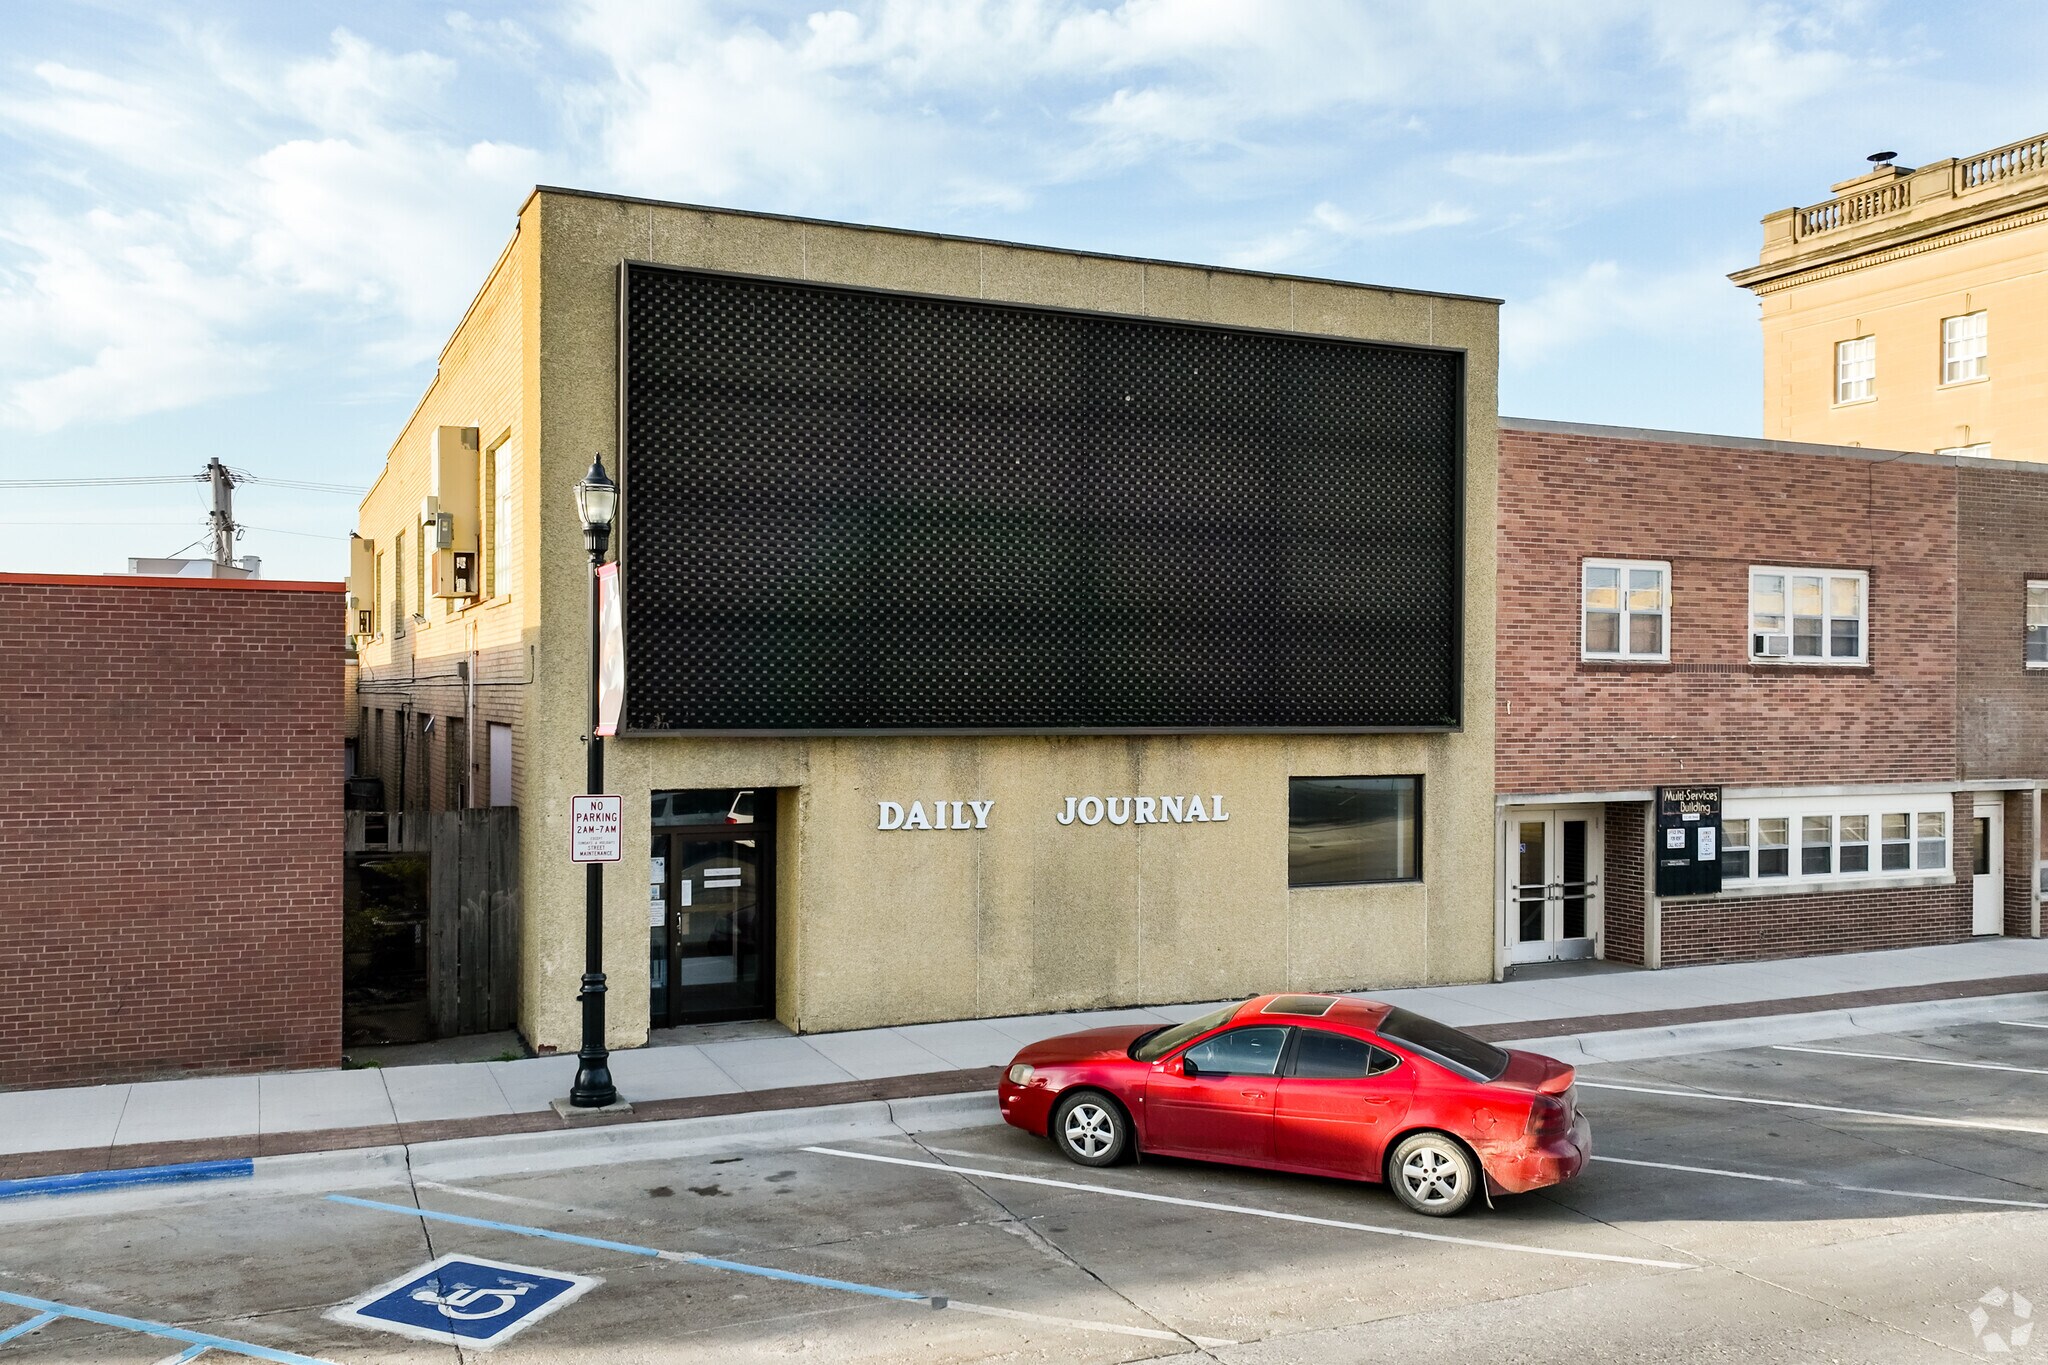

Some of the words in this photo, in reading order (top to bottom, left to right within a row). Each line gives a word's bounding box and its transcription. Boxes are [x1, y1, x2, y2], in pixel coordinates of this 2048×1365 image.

[1664, 789, 1718, 802] Multi-Services
[591, 802, 603, 811] NO
[1680, 801, 1711, 815] Building
[576, 812, 617, 822] PARKING
[877, 800, 995, 831] DAILY
[1056, 794, 1231, 826] JOURNAL
[576, 825, 617, 834] 2AM-7AM
